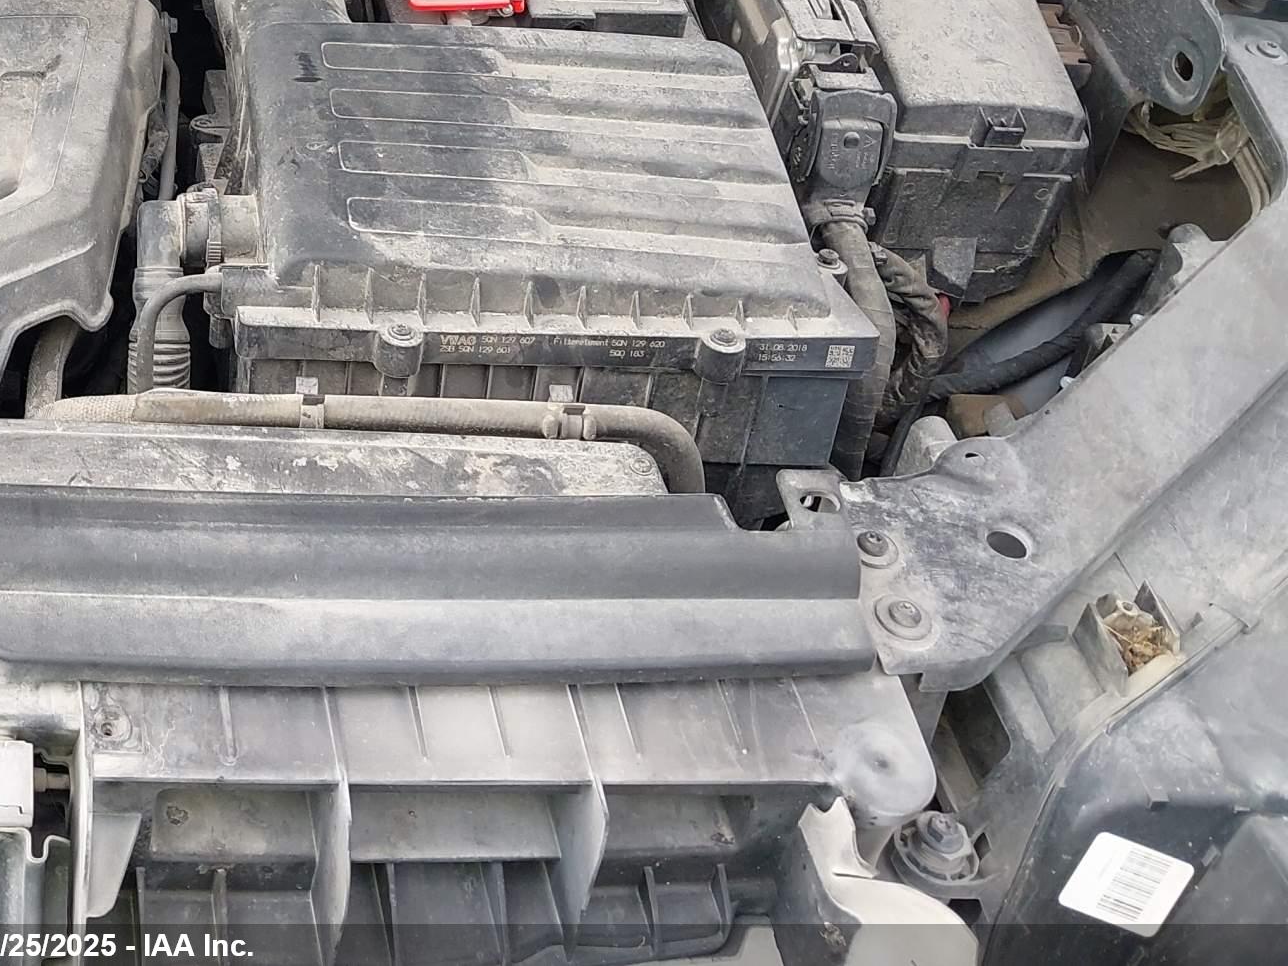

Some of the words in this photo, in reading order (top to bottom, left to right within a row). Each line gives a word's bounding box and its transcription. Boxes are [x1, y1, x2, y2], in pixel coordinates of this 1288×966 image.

[519, 336, 536, 345] 607
[632, 339, 647, 347] 129
[649, 340, 666, 348] 620
[478, 345, 494, 354] 129
[496, 345, 511, 354] 601
[630, 349, 646, 358] 183
[758, 353, 797, 362] 15:56:32
